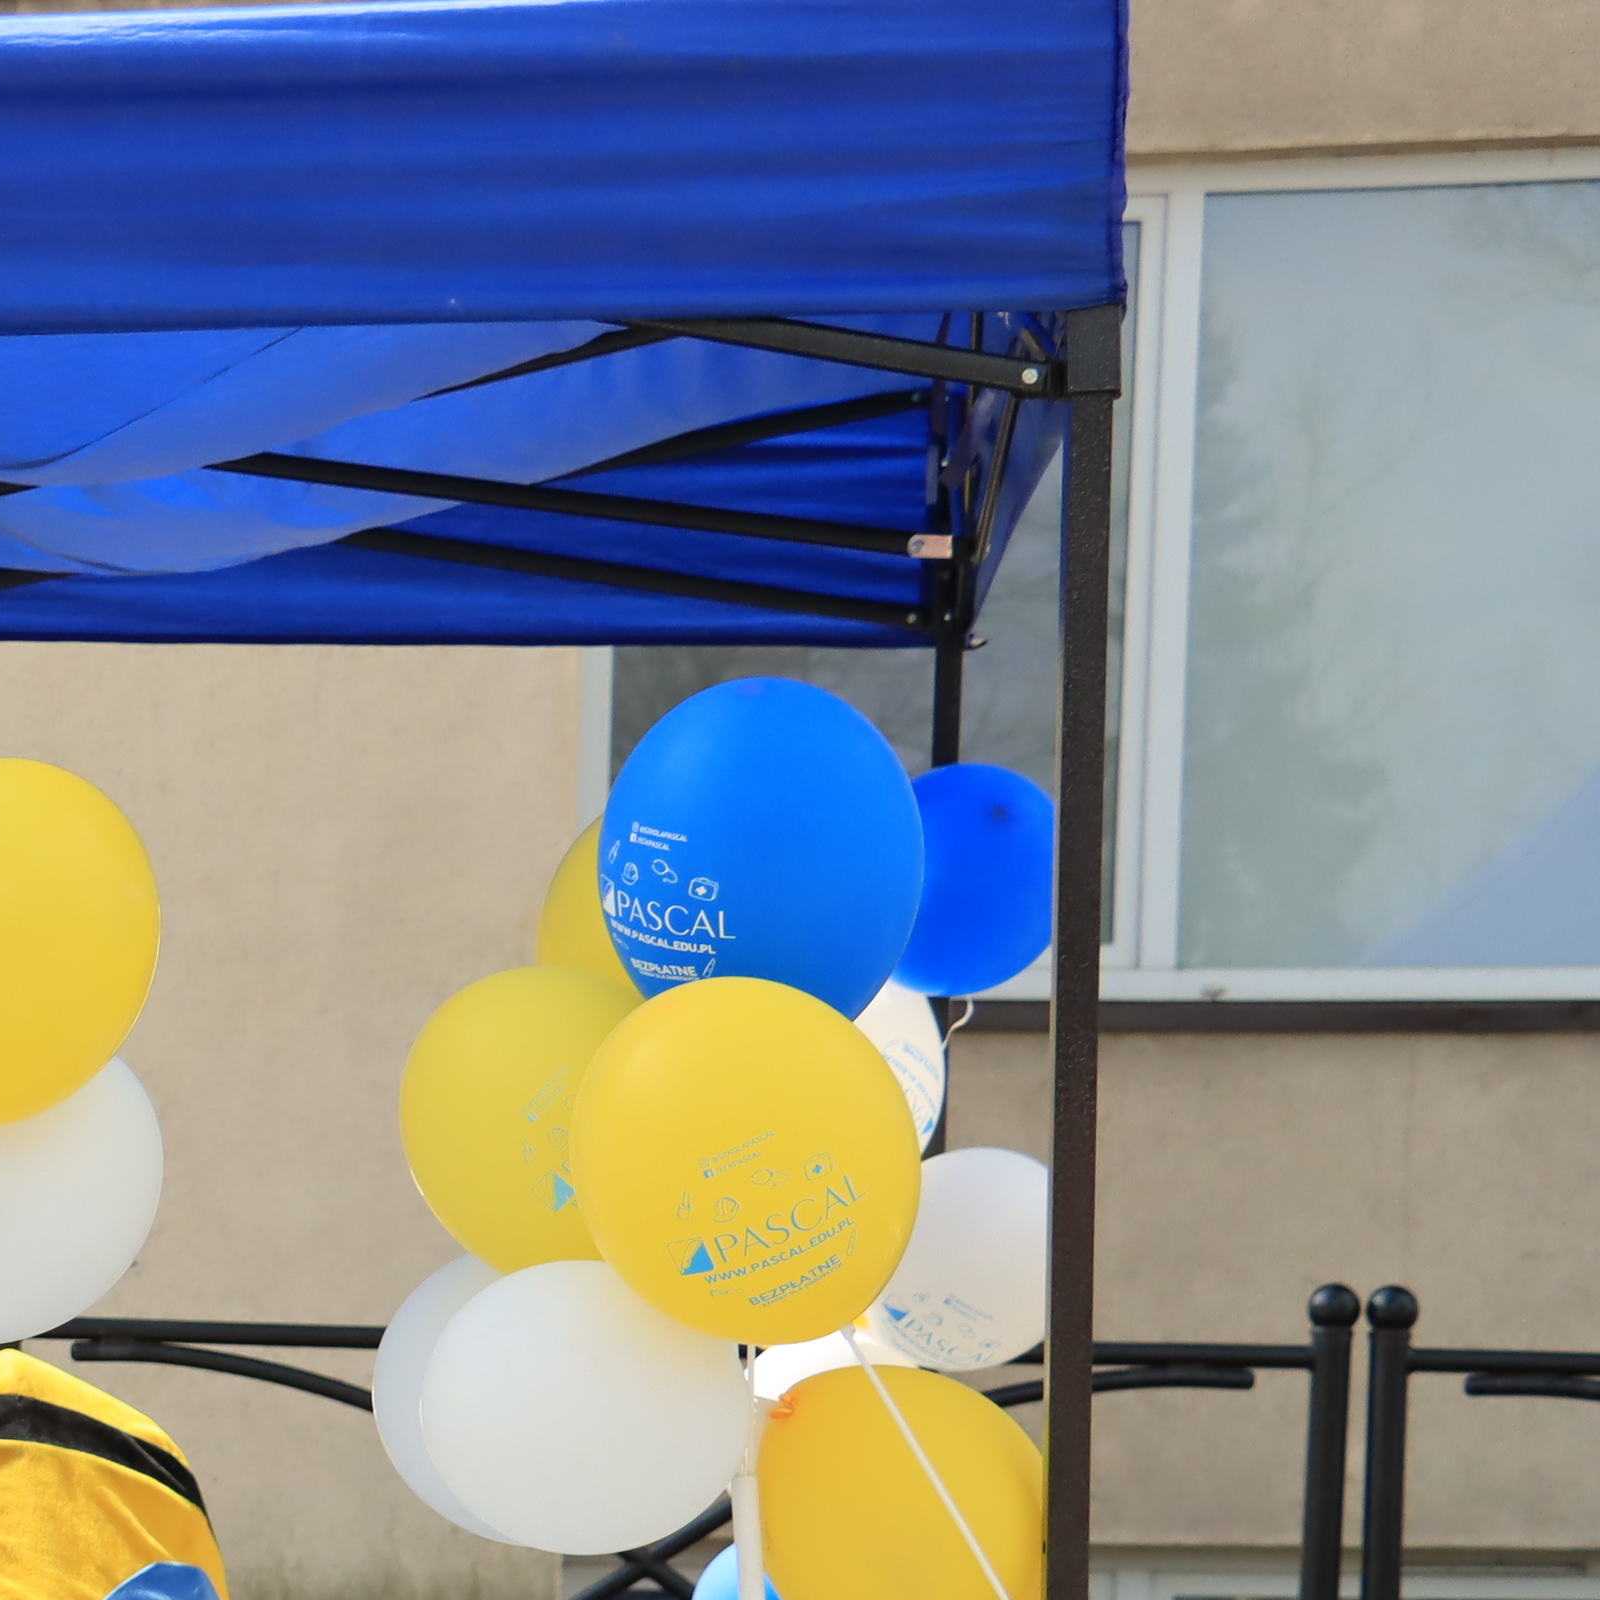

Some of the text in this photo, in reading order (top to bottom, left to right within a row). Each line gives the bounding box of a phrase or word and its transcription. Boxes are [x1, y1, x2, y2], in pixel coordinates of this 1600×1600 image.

[610, 918, 717, 955] WWW.PASCAL.EDU.PL
[617, 889, 736, 939] PASCAL
[714, 1175, 866, 1263] PASCAL
[704, 1217, 854, 1284] WWW.PASCAL.EDU.PL
[748, 1253, 842, 1306] BEZPŁATNE
